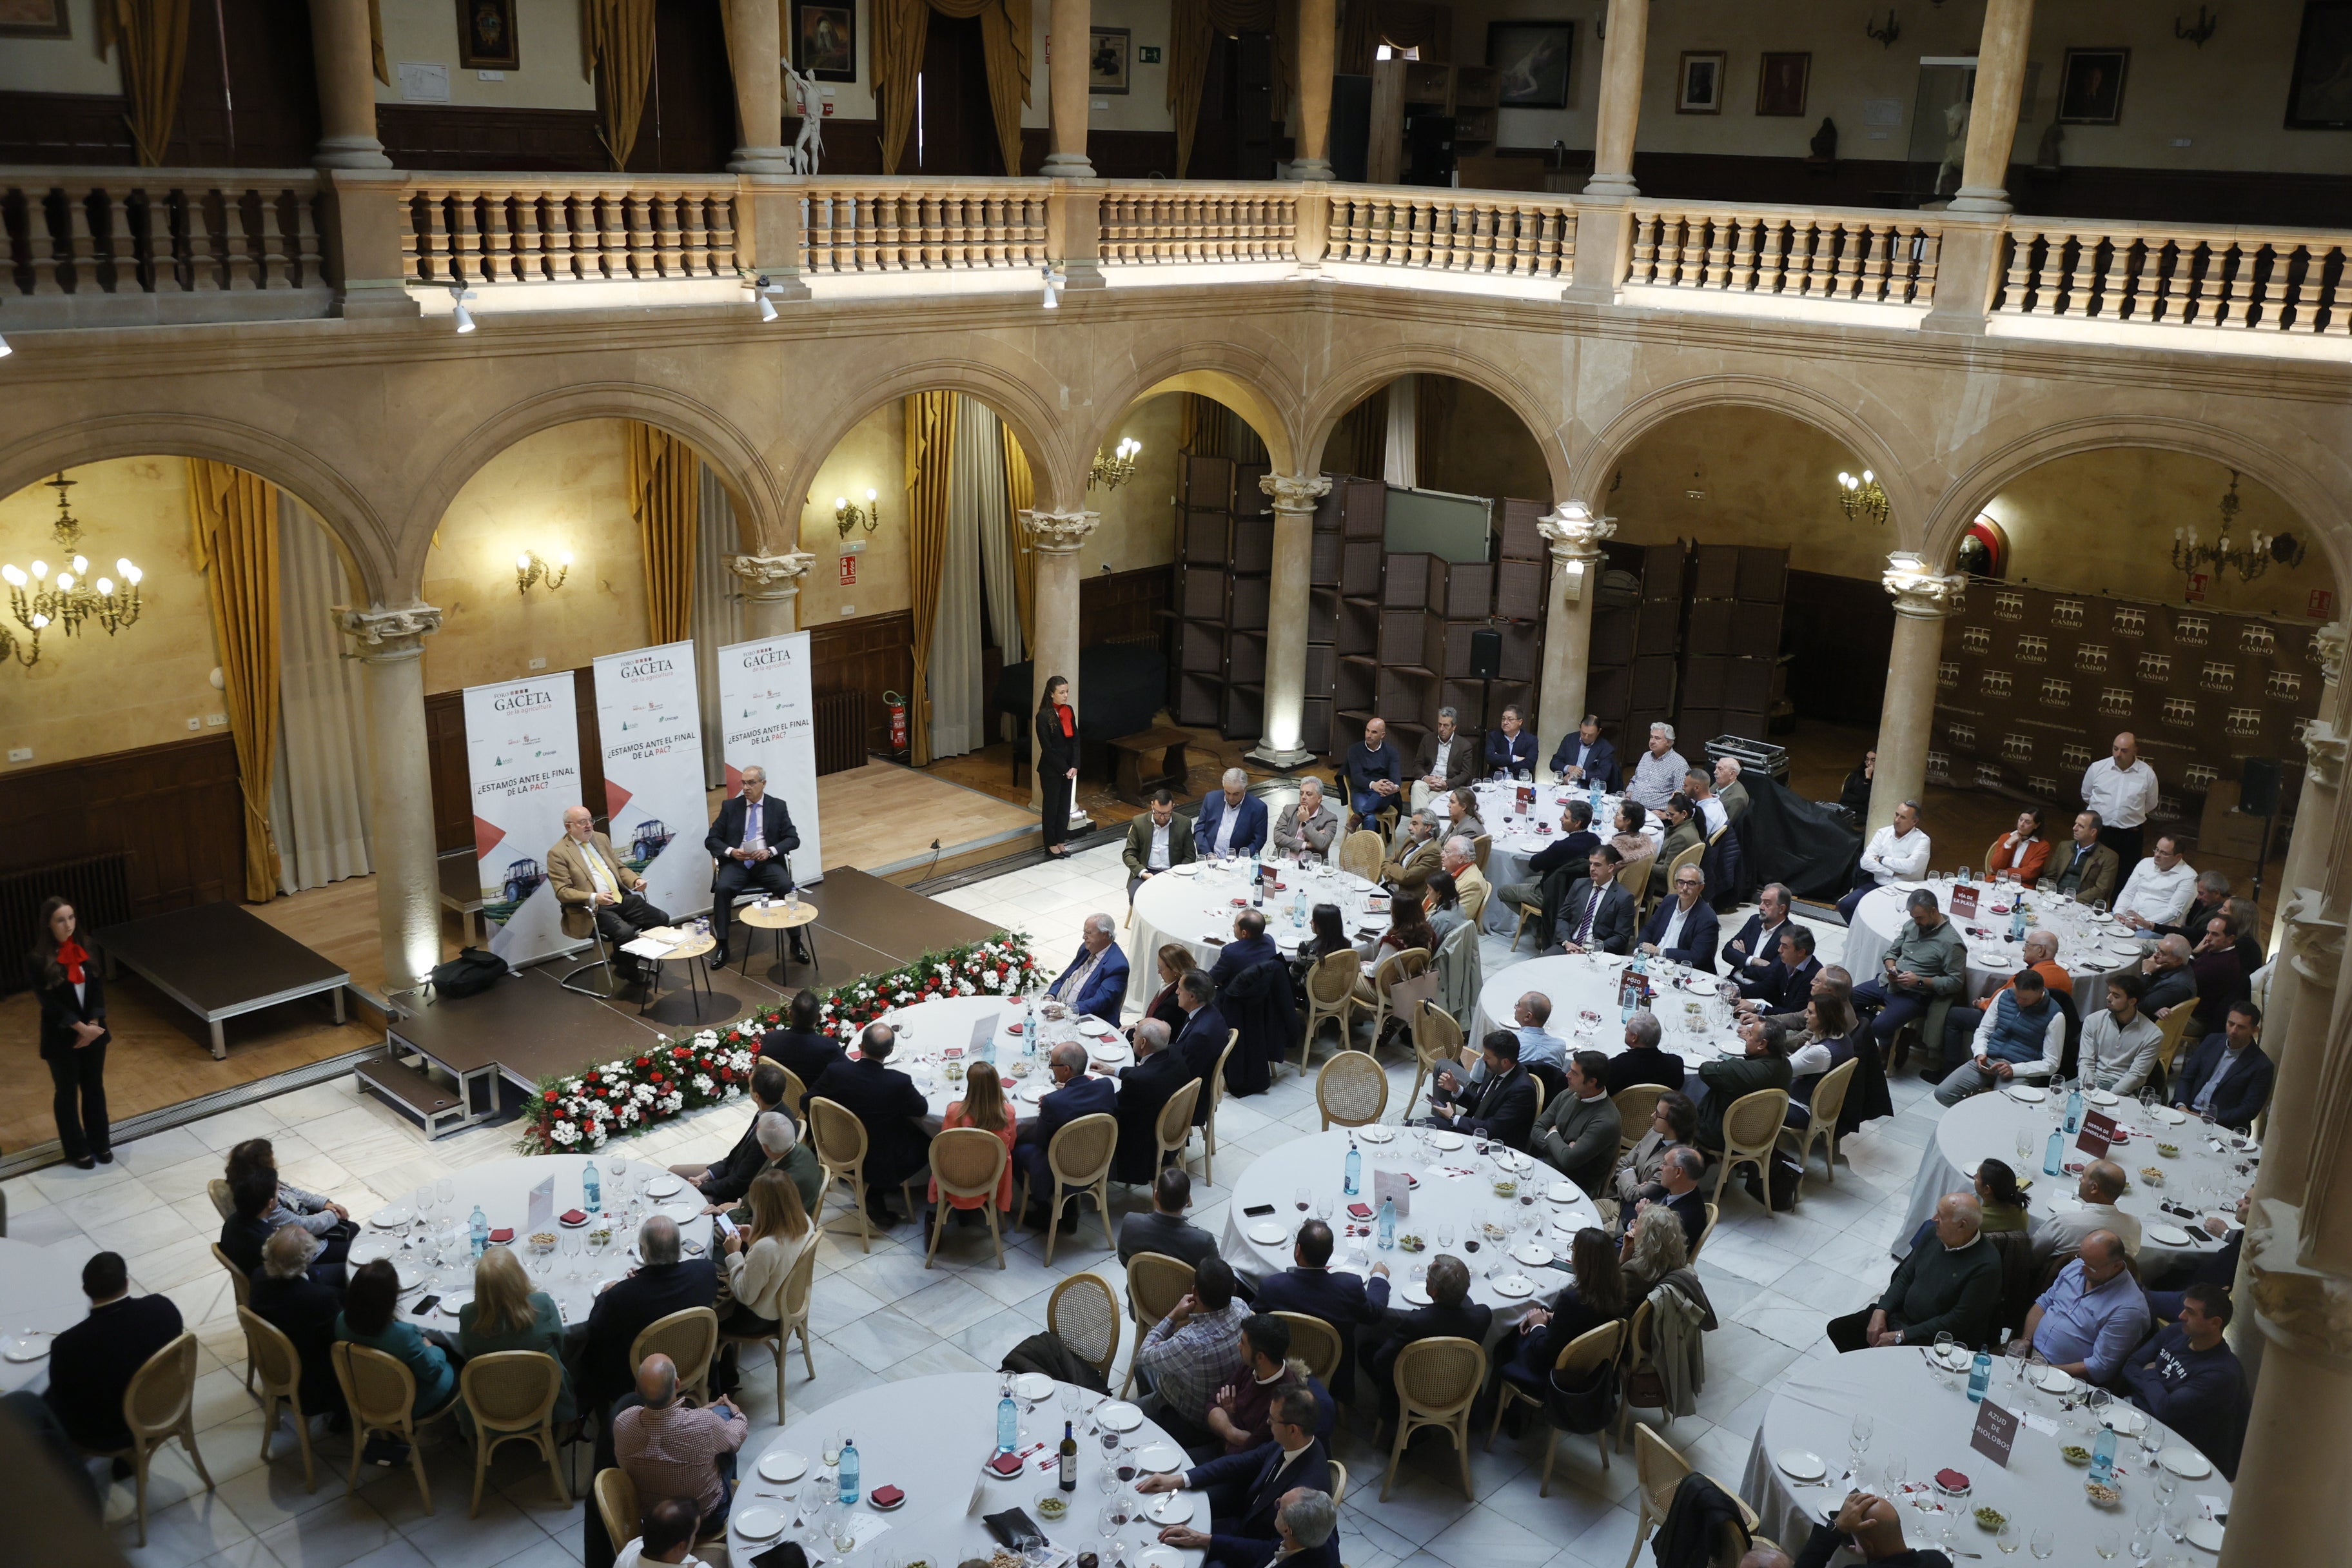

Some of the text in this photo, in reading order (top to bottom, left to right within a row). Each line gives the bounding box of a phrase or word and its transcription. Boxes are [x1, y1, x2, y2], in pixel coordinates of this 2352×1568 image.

[1994, 610, 2023, 620] CASINO
[2051, 618, 2082, 628] CASINO
[2112, 626, 2144, 636] CASINO
[2175, 635, 2208, 645] CASINO
[1963, 645, 1988, 654] CASINO
[2239, 645, 2273, 655] CASINO
[743, 650, 790, 668] GACETA
[2015, 653, 2047, 663] CASINO
[2306, 654, 2326, 663] CASI
[621, 660, 673, 678] GACETA
[765, 661, 791, 671] agricultura
[2074, 662, 2106, 672] CASINO
[645, 671, 673, 681] agricultura
[2136, 671, 2169, 681] CASINO
[2200, 681, 2233, 692] CASINO
[1981, 687, 2012, 697] CASINO
[2265, 689, 2298, 701] CASINO
[495, 691, 552, 711] GACETA
[2039, 697, 2070, 707] CASINO
[521, 703, 552, 714] agricultura
[2099, 706, 2132, 716] CASINO
[2161, 716, 2194, 727] CASINO
[729, 729, 761, 744] ¿ESTAMOS
[763, 725, 779, 734] ANTE
[790, 719, 809, 728] FINAL
[772, 731, 787, 741] PAC?
[2224, 727, 2259, 736] CASINO
[608, 743, 643, 759] ¿ESTAMOS
[646, 738, 663, 749] ANTE
[674, 732, 696, 741] FINAL
[645, 749, 654, 758] LA
[656, 745, 671, 755] PAC?
[2001, 750, 2032, 761] CASINO
[478, 778, 516, 794] ¿ESTAMOS
[519, 774, 540, 785] ANTE
[552, 767, 574, 778] FINAL
[507, 781, 549, 796] DE LA PAC?
[2182, 783, 2210, 793] CASIN
[2151, 812, 2180, 821] ASINO
[2087, 1122, 2102, 1132] SIERRA
[2082, 1126, 2110, 1142] CANDELARIO
[1988, 1411, 2006, 1426] AZUD
[1991, 1424, 2000, 1433] DE
[1976, 1425, 2010, 1451] RIOLOBOS
